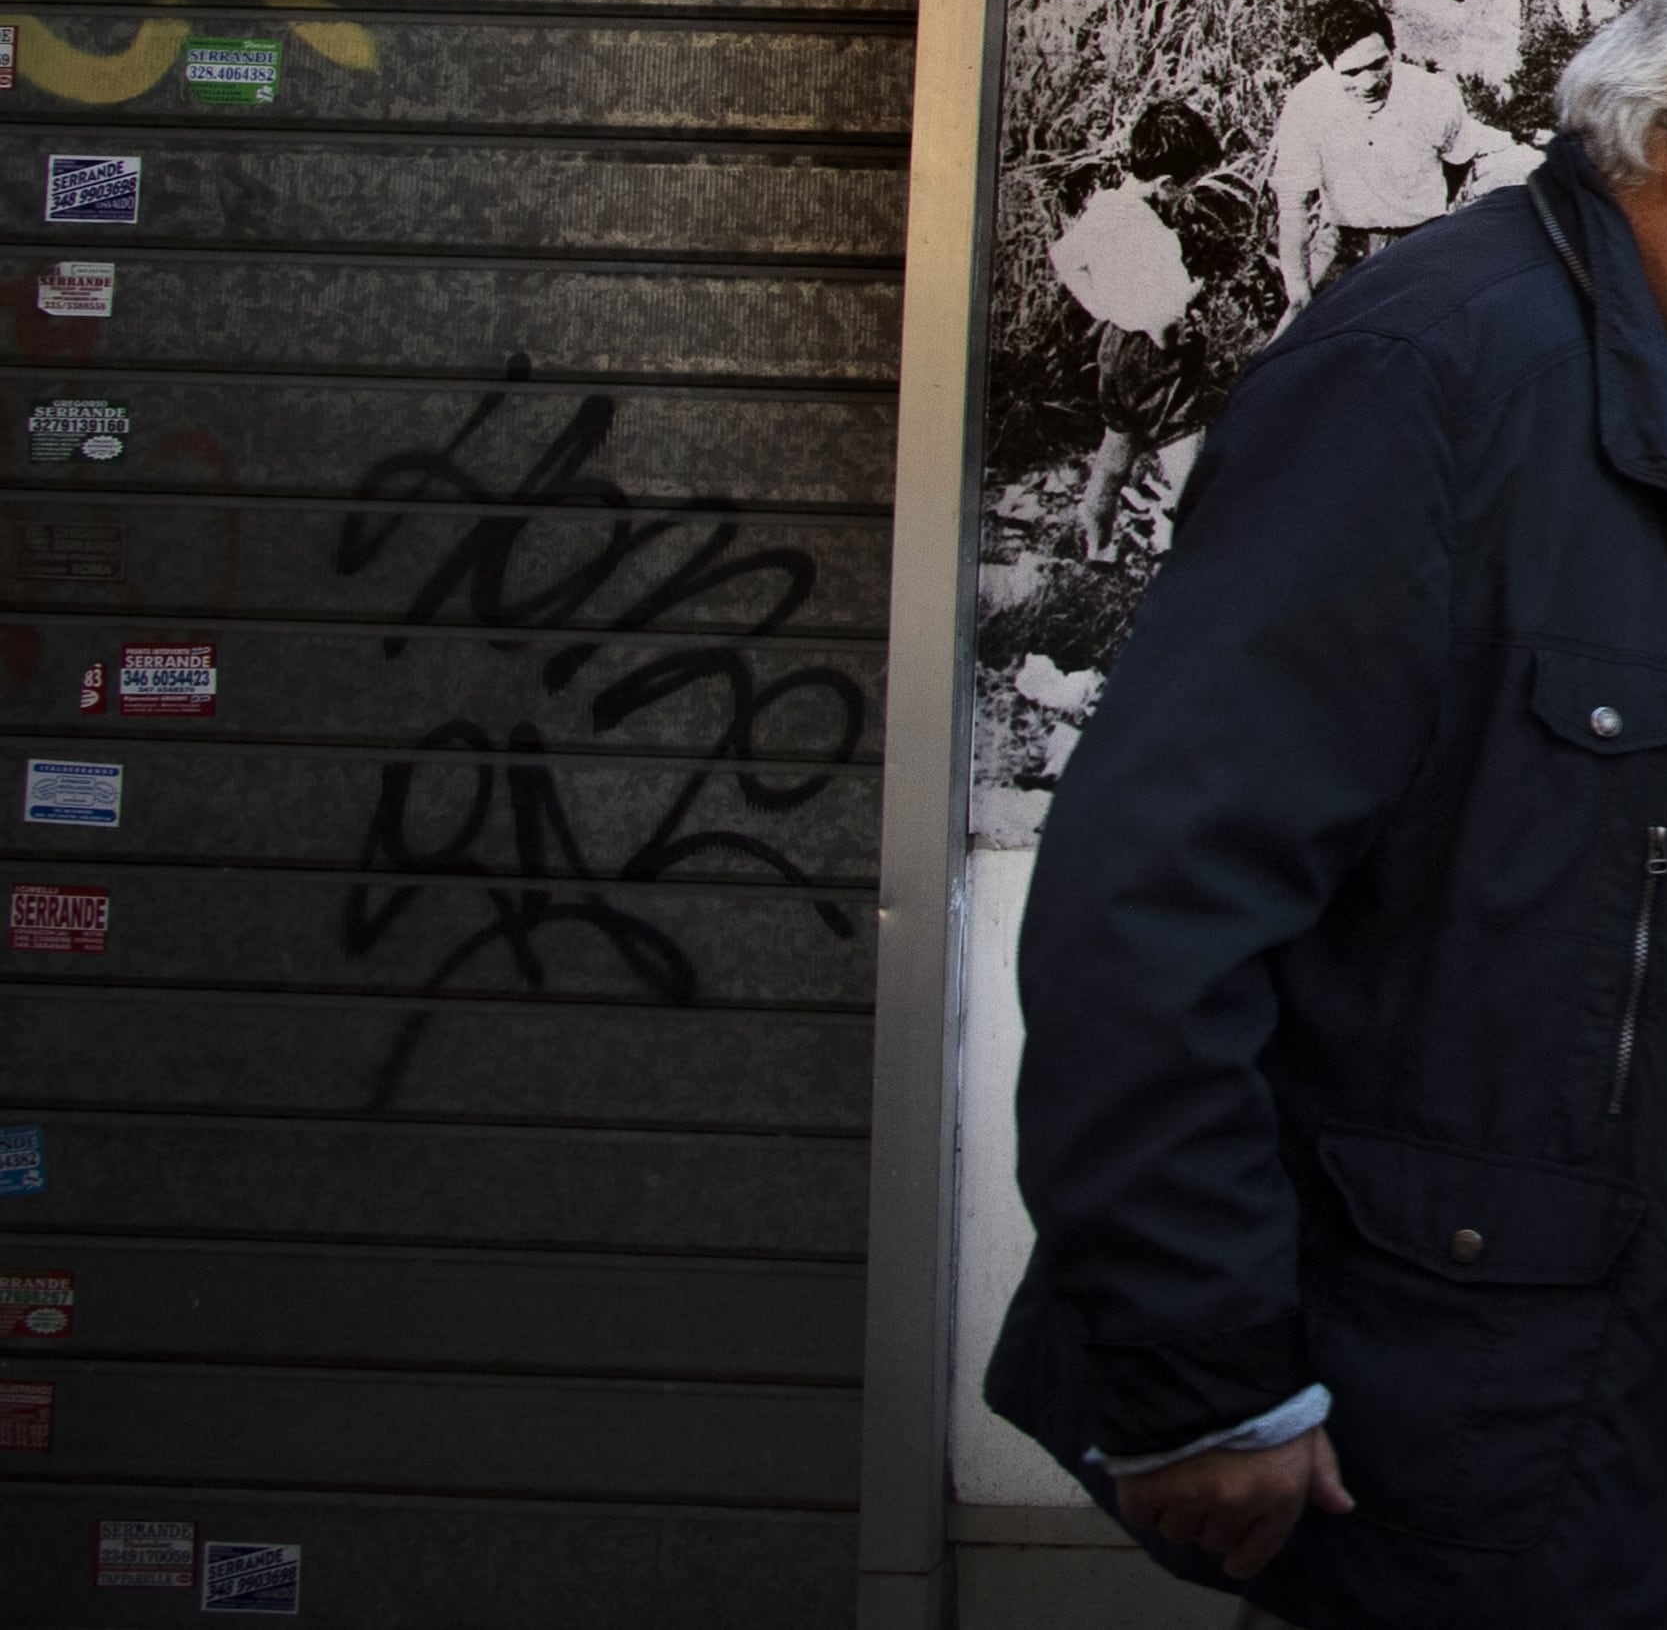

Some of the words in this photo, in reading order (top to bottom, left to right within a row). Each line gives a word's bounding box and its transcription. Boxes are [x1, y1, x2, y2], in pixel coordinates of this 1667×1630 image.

[190, 51, 273, 63] SERRANDE
[52, 160, 124, 191] SERRANDE
[53, 192, 76, 209] 348
[79, 177, 137, 204] 9903698
[40, 277, 111, 287] SERRANDE
[53, 400, 108, 408] GREGORIO
[34, 407, 126, 418] SERRANDE
[33, 420, 125, 431] 3279139160
[125, 656, 211, 668] SERRANDE
[124, 670, 148, 686] 346
[153, 670, 210, 686] 6054423
[14, 895, 107, 929] SERRANDE
[0, 1151, 36, 1167] 4382
[103, 1523, 191, 1538] SERRANDE
[209, 1548, 283, 1579] SERRANDE
